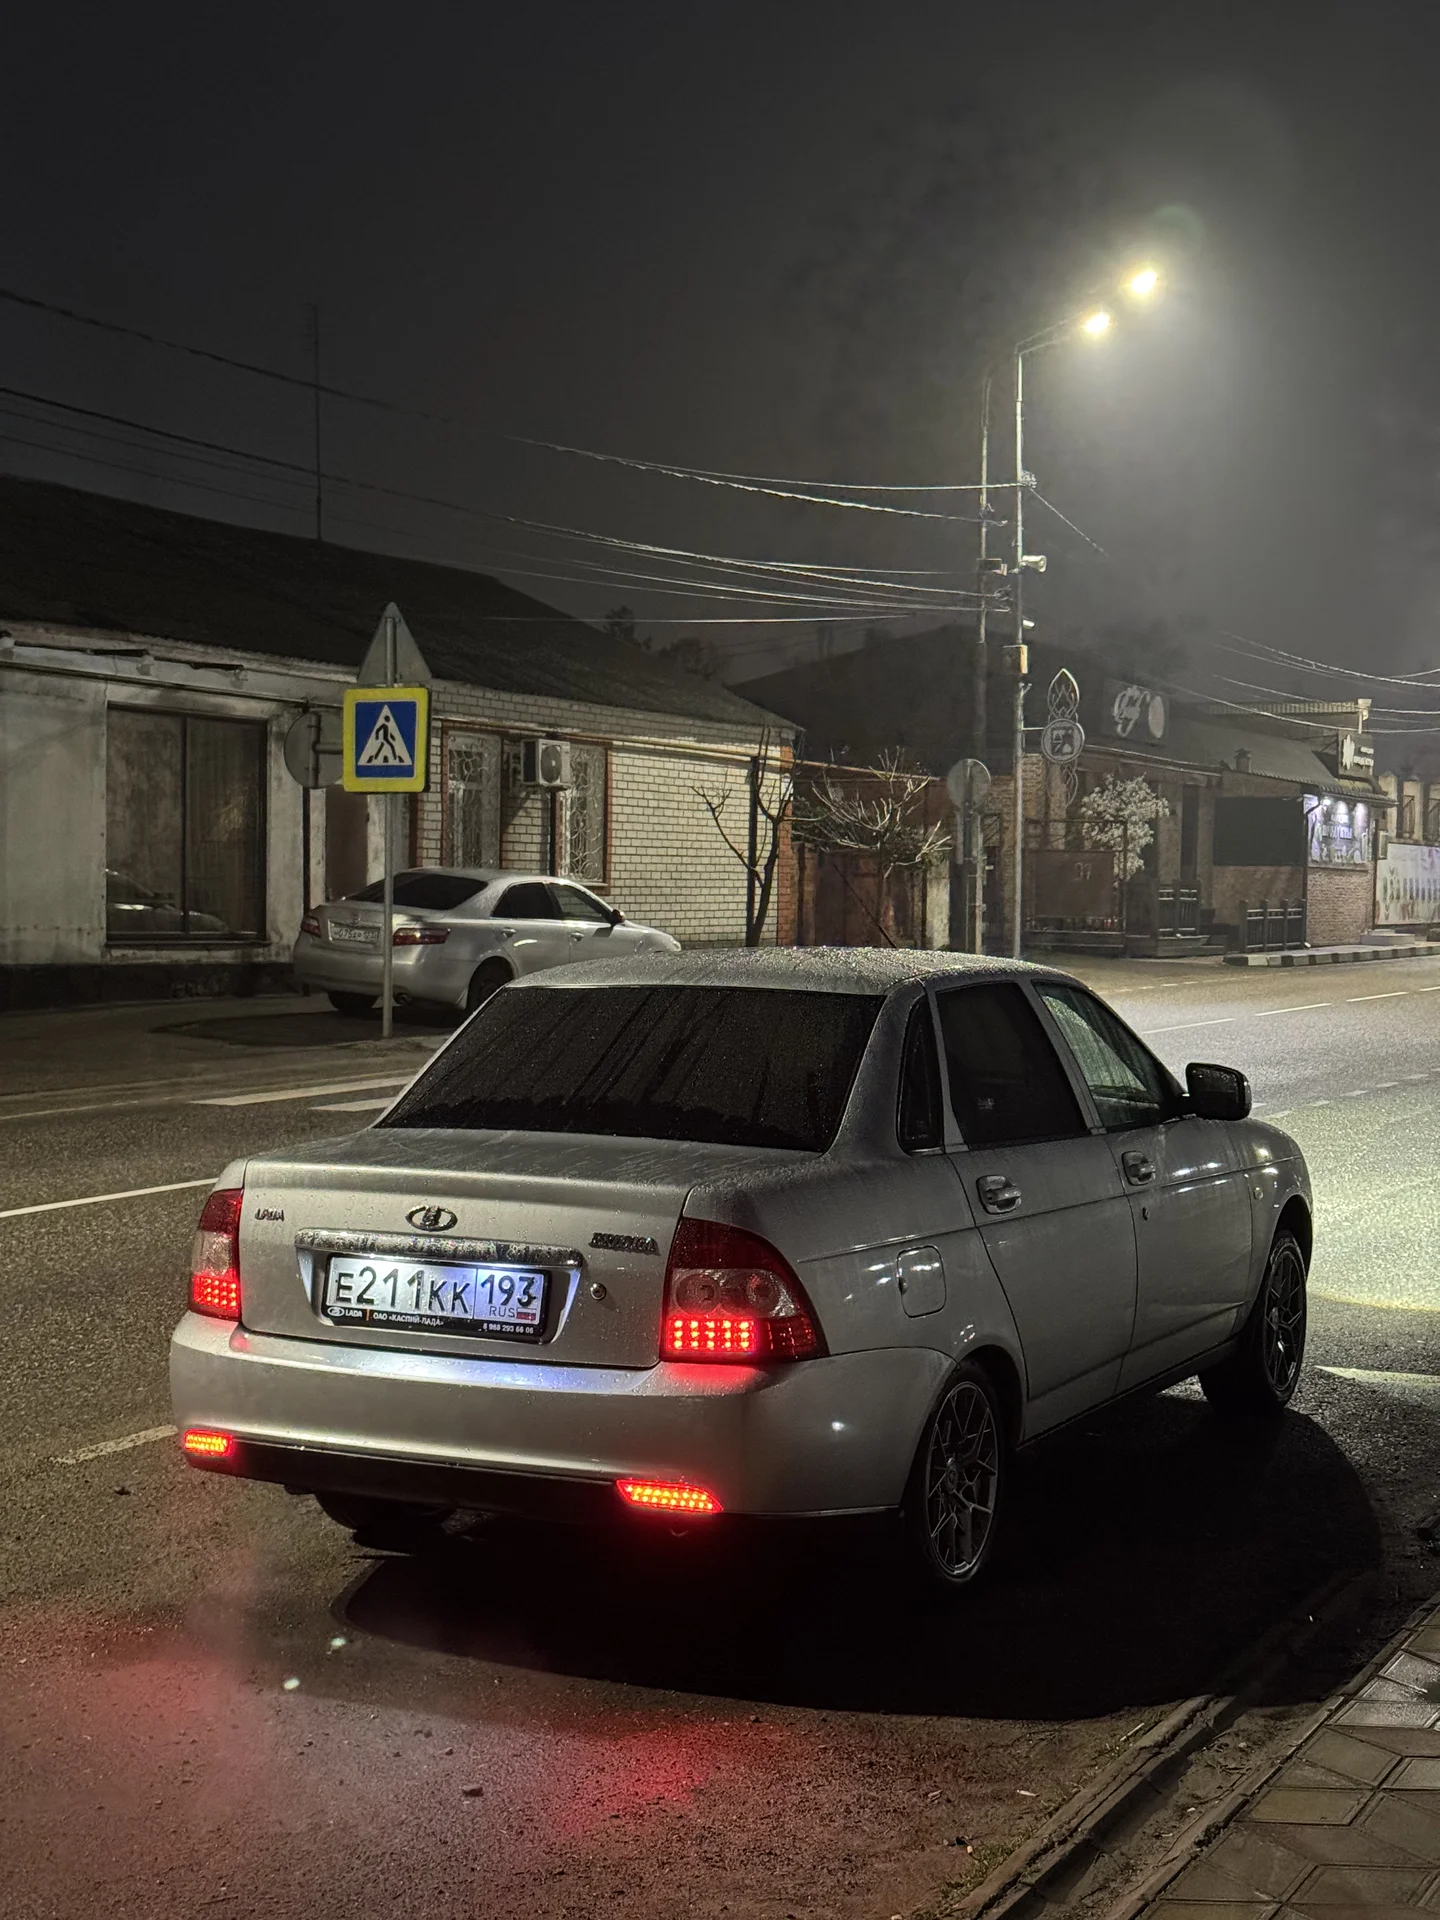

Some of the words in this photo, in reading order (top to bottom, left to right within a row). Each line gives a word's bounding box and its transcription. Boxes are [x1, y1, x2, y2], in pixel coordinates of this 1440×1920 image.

[481, 1274, 537, 1307] 193
[345, 1309, 363, 1318] LADA
[489, 1305, 516, 1318] RUS
